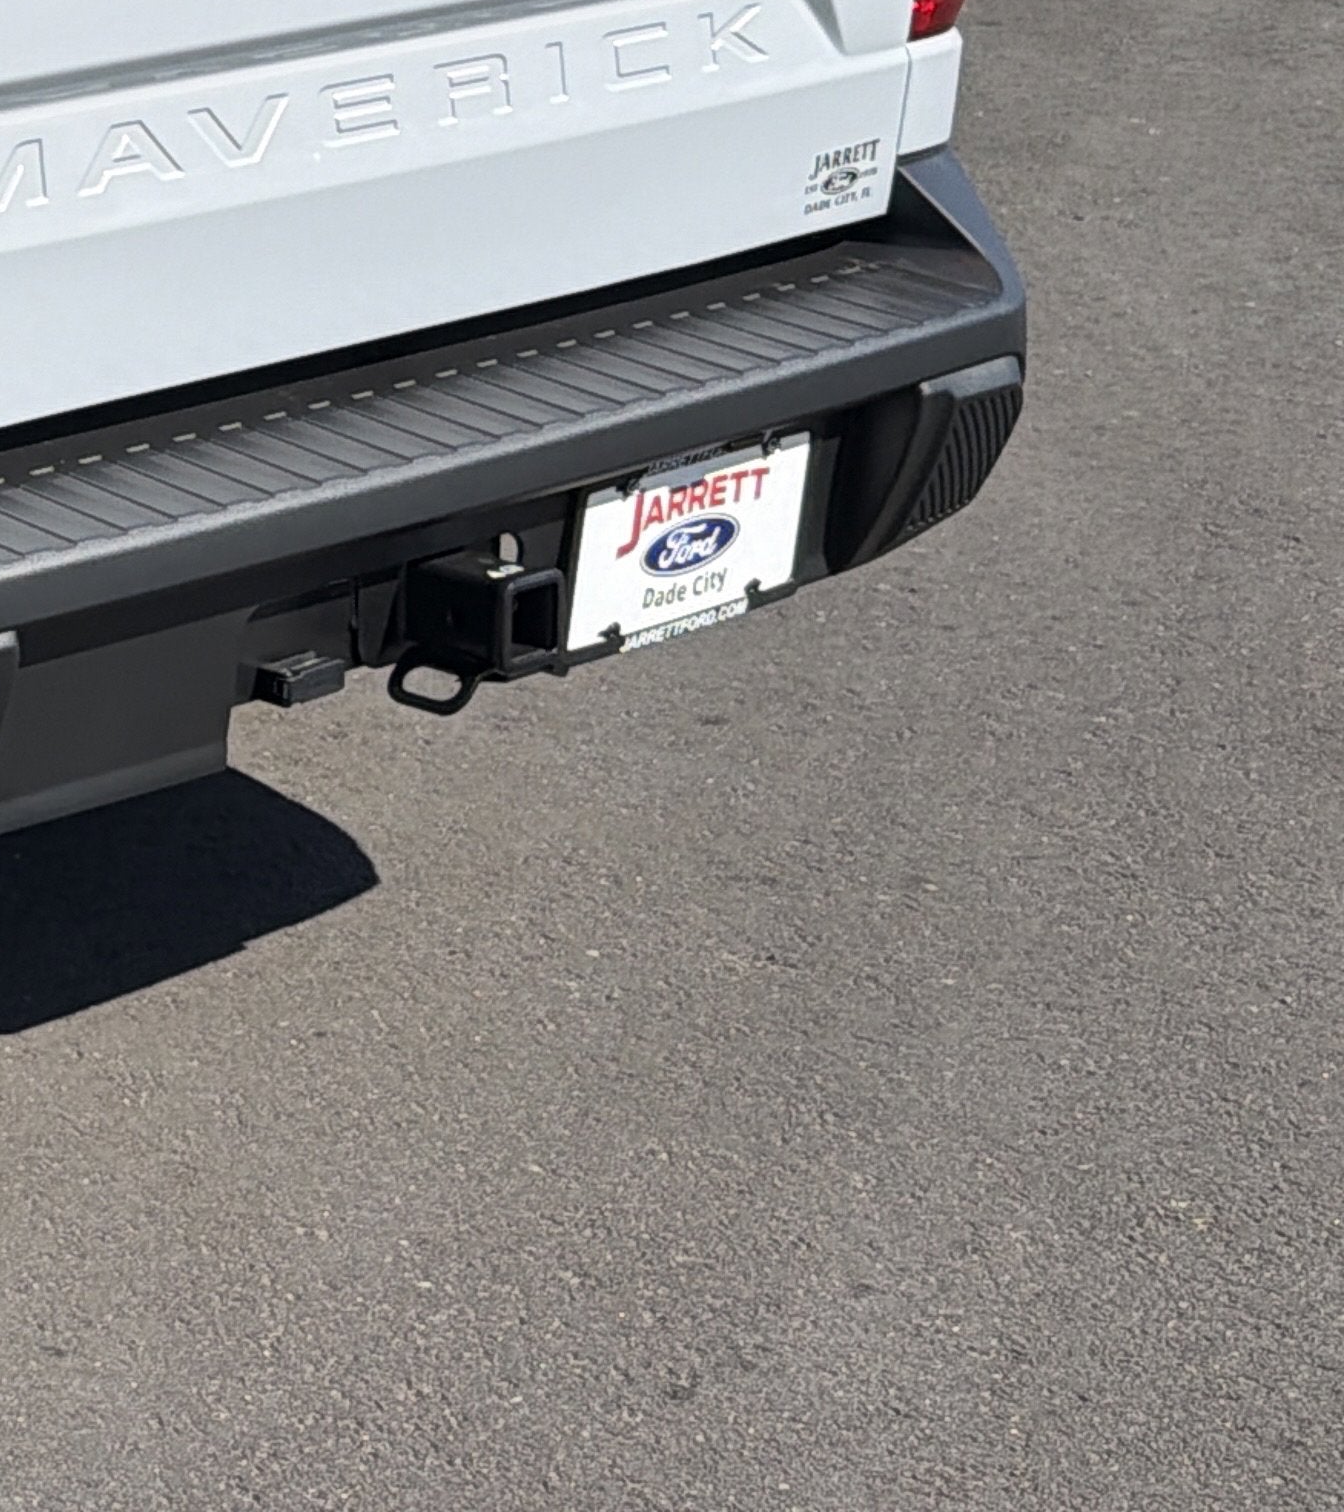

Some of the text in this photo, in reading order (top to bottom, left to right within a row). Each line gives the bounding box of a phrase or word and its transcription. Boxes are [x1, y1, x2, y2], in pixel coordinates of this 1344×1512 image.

[808, 138, 880, 181] JARRETT
[616, 466, 770, 560] JARRETT
[658, 522, 719, 569] Ford
[642, 567, 729, 609] Dade City
[619, 595, 748, 653] JARRETTFORD.COM
